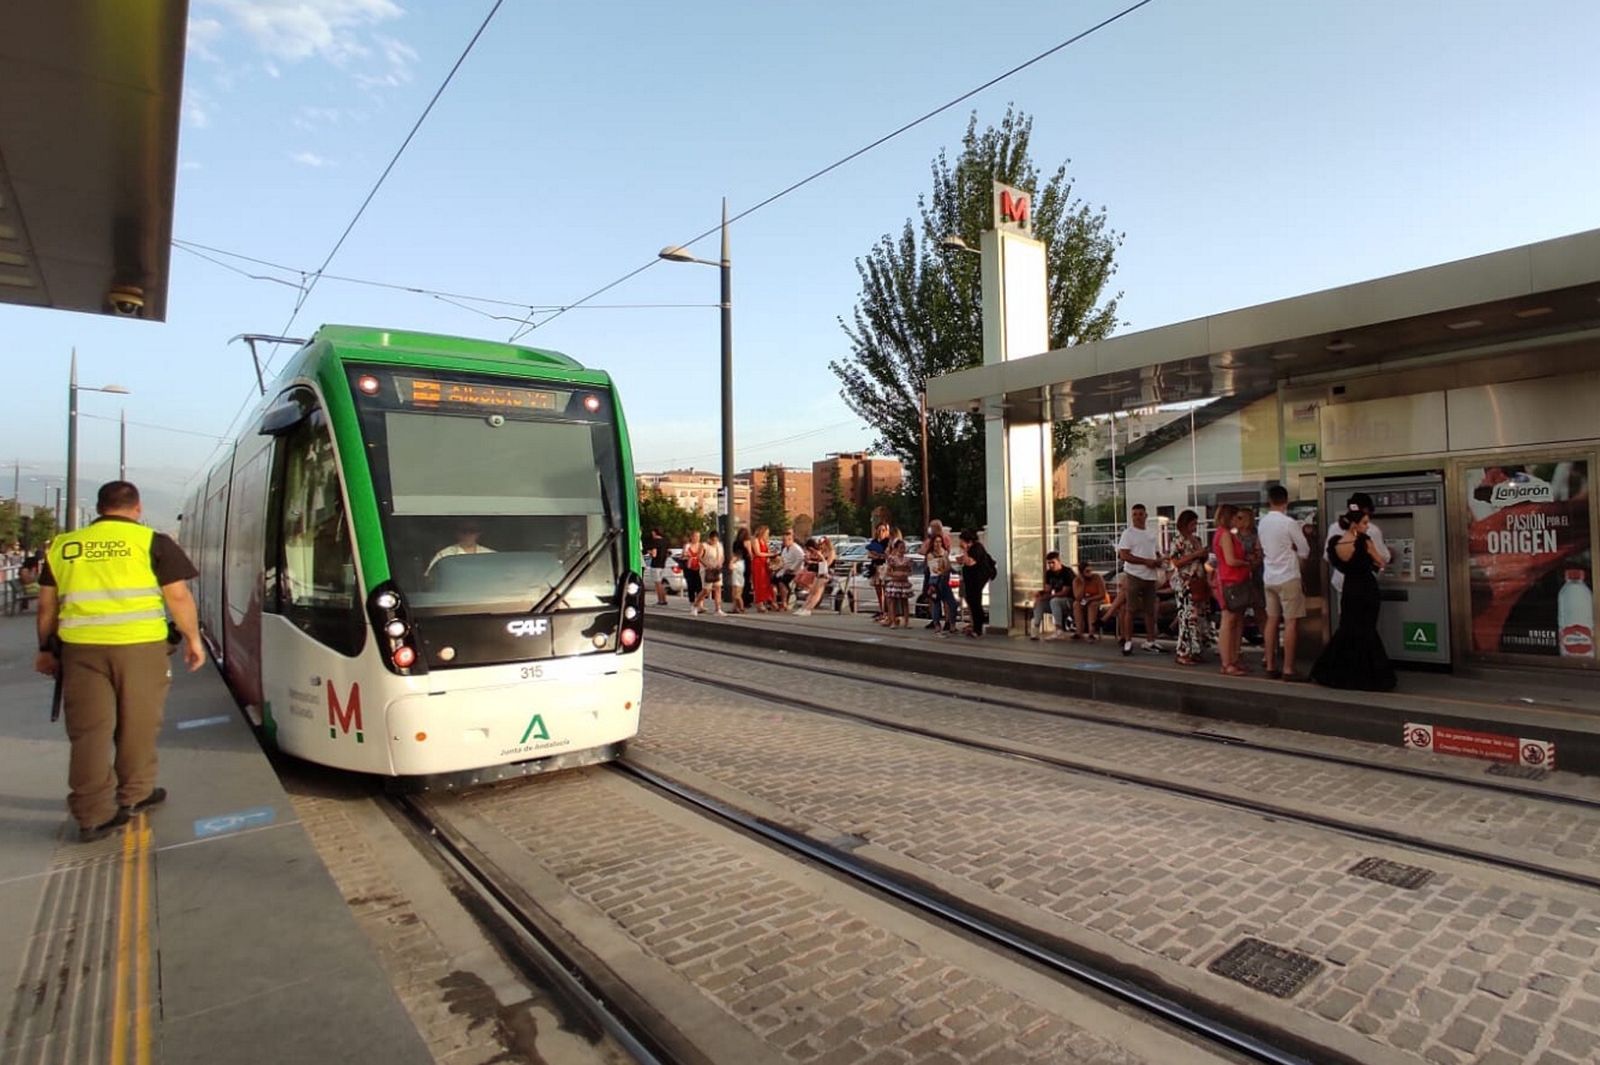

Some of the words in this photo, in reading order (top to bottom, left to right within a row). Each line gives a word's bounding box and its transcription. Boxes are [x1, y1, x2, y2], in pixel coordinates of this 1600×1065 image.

[1506, 511, 1546, 530] PASIÓN
[84, 540, 126, 550] grupo
[1487, 529, 1558, 554] ORIGEN
[84, 548, 131, 559] control
[507, 619, 547, 637] CAF
[520, 665, 544, 679] 315
[327, 679, 364, 743] M
[500, 746, 522, 757] Junta
[523, 744, 533, 752] de
